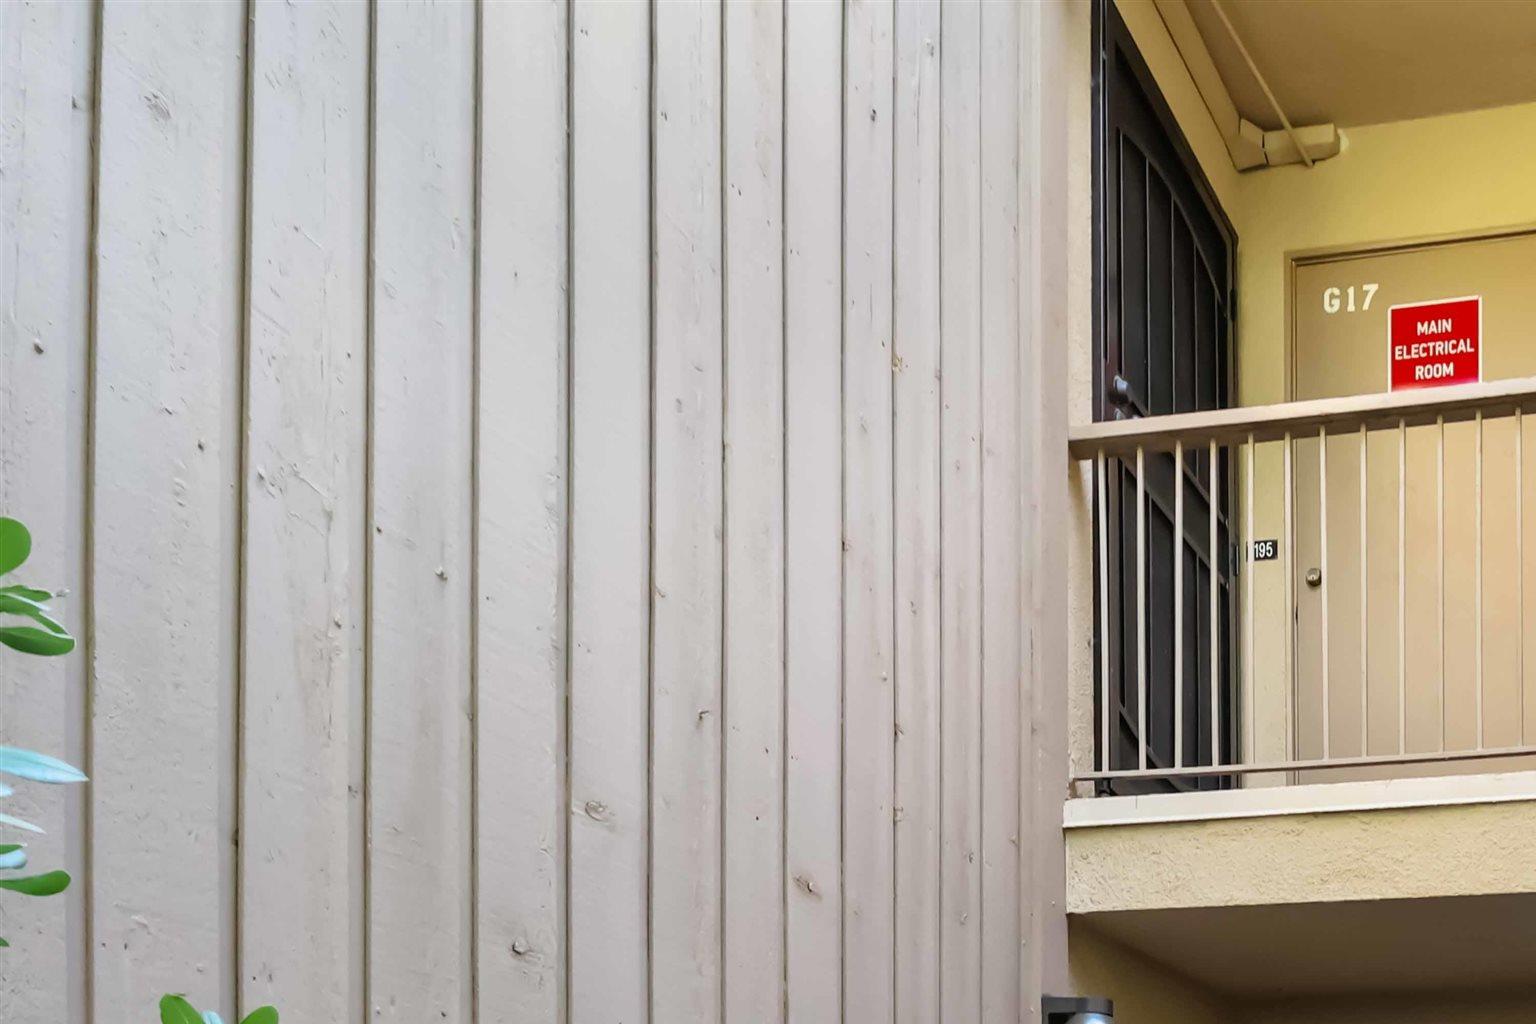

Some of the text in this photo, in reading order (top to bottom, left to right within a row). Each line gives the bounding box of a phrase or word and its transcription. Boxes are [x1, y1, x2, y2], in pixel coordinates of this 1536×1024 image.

[1323, 283, 1379, 314] G17
[1417, 318, 1452, 336] MAIN
[1395, 338, 1474, 360] ELECTRICAL
[1415, 362, 1454, 380] ROOM
[1253, 541, 1273, 558] 195
